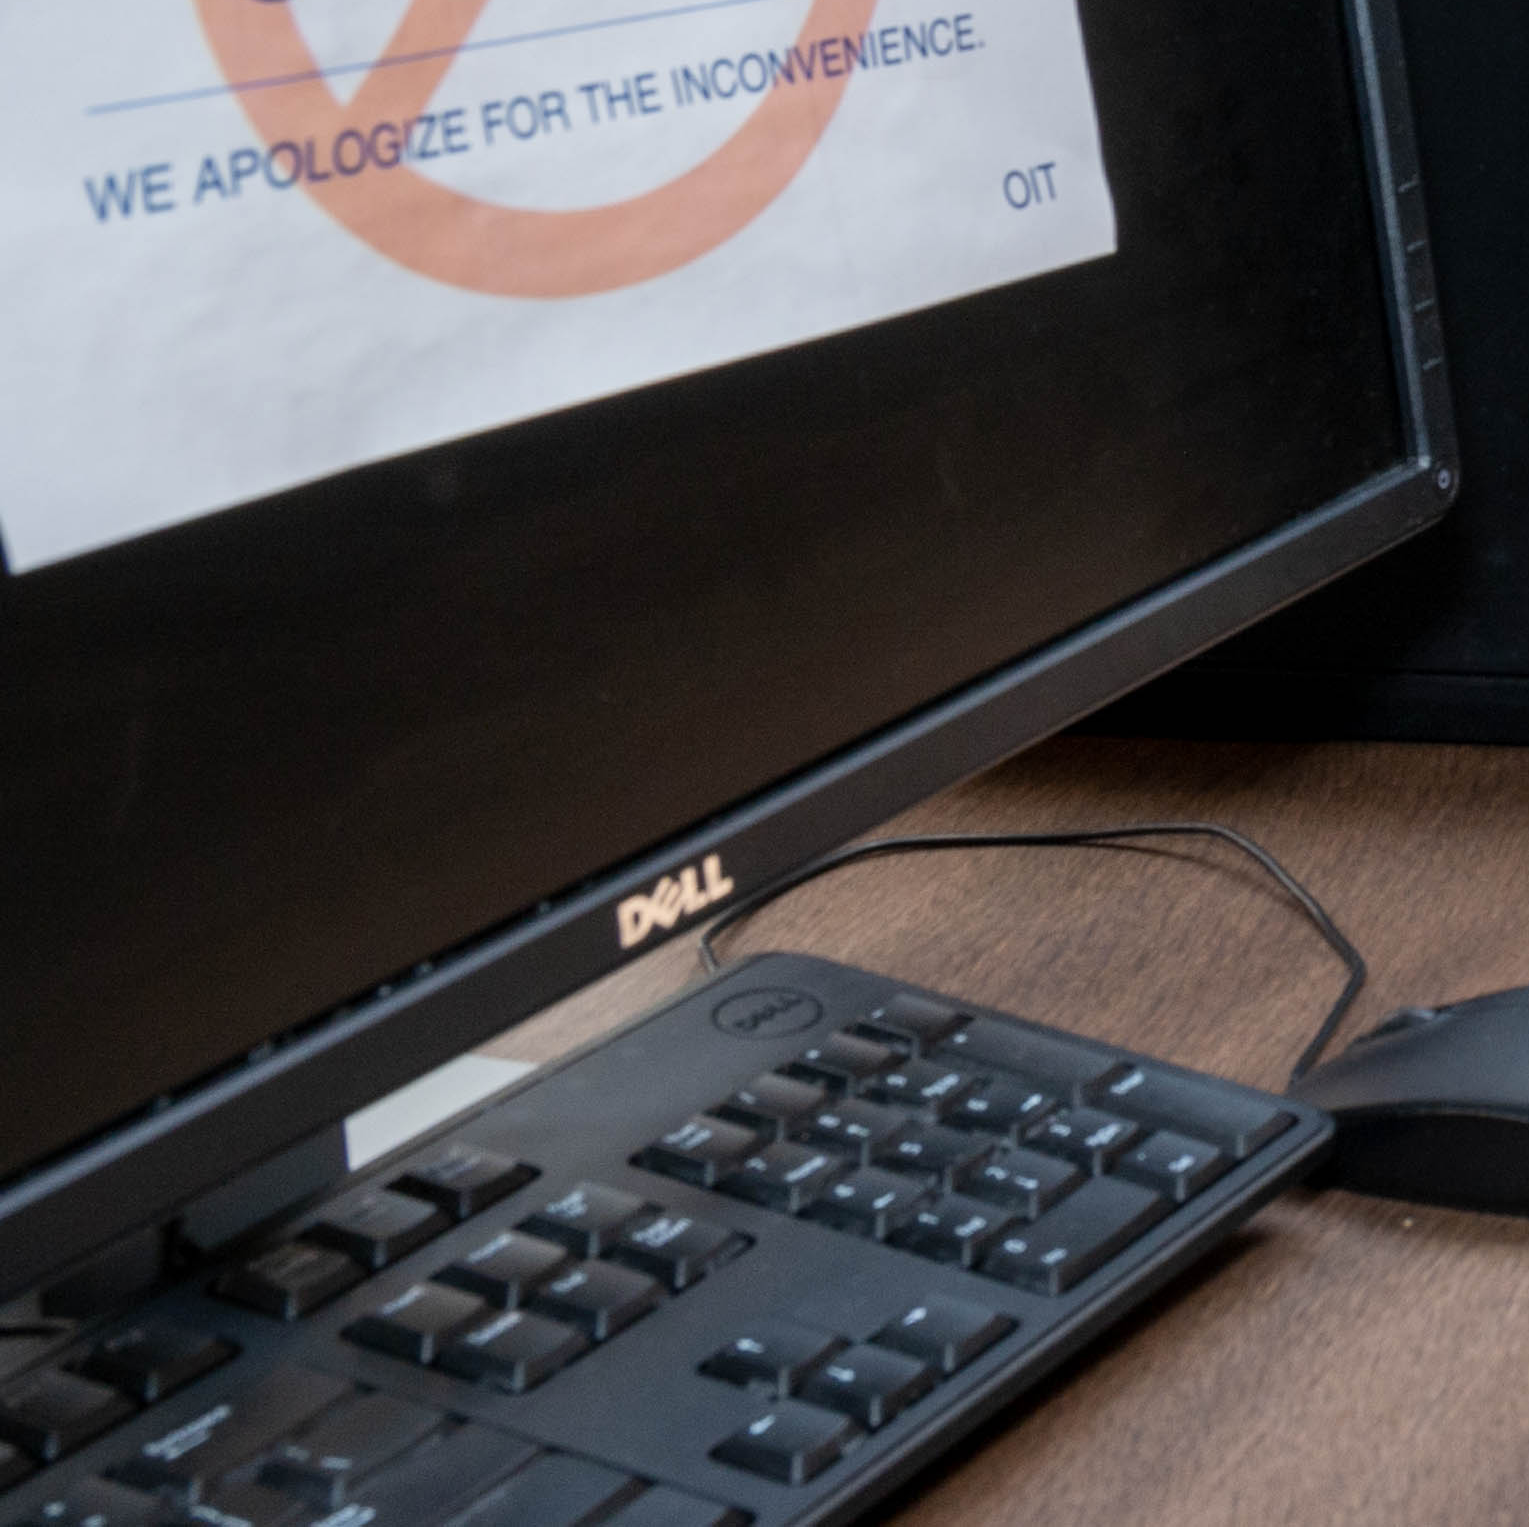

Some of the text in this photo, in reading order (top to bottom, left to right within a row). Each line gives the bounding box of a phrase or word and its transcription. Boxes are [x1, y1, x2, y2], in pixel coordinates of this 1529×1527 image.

[84, 13, 986, 222] WE APOLOGIZE FOR THE INCONVENIENCE.
[1002, 162, 1058, 210] OIT
[616, 852, 735, 950] DELL
